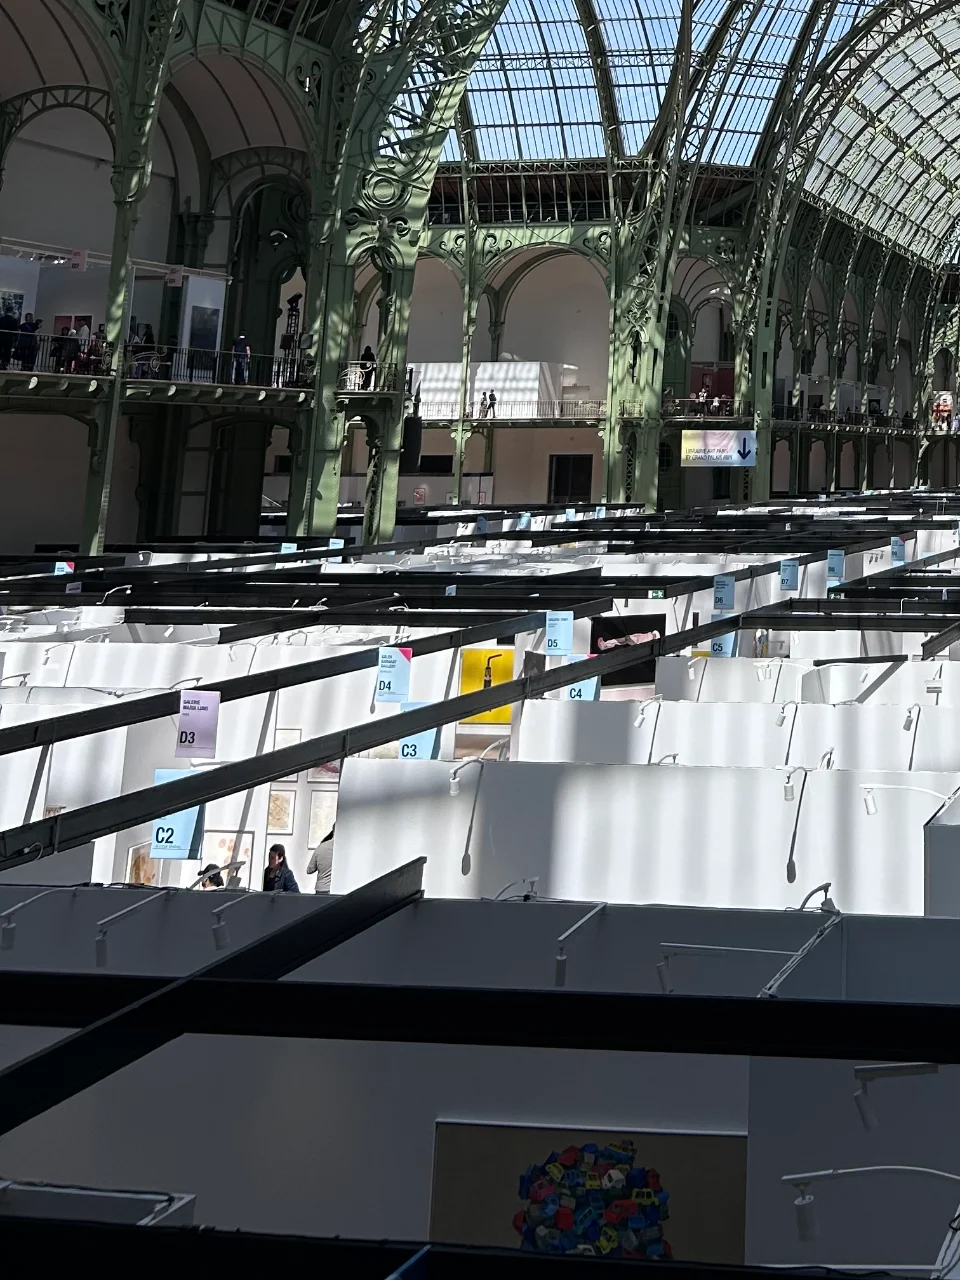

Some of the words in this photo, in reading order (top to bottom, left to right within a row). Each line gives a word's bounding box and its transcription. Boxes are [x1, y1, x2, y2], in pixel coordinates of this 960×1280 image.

[547, 638, 558, 648] D5
[712, 642, 723, 652] C5
[378, 680, 392, 692] D4
[569, 687, 583, 699] C4
[179, 730, 196, 744] D3
[401, 743, 417, 758] C3
[155, 826, 175, 844] C2
